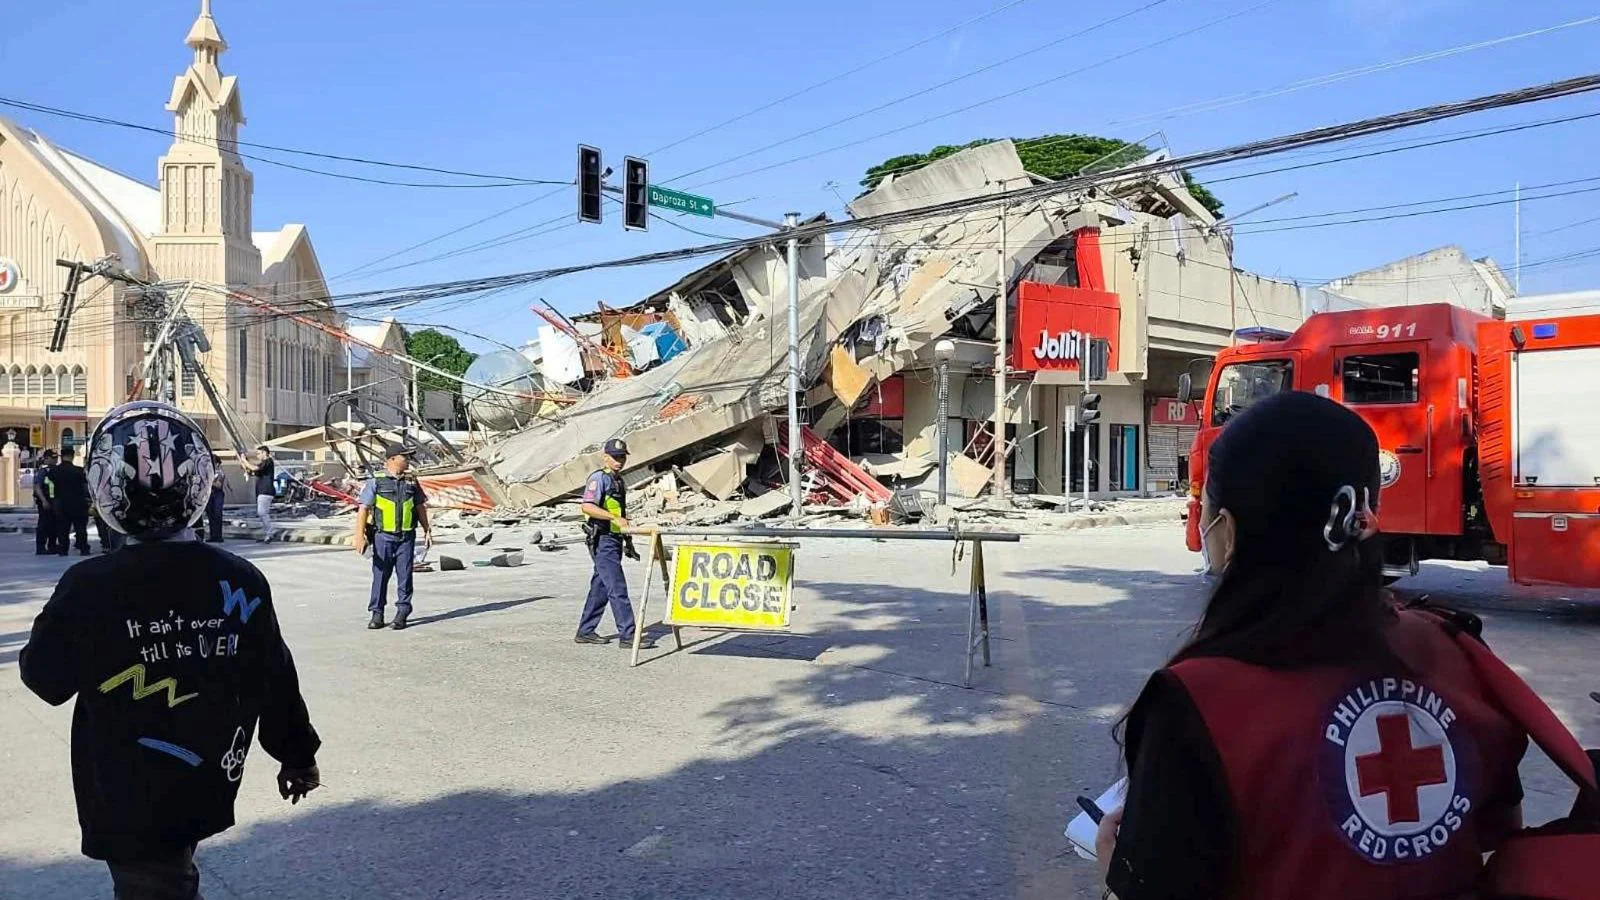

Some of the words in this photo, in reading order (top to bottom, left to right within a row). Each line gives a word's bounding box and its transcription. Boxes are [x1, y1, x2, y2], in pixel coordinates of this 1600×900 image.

[652, 191, 685, 206] Daproza
[1032, 329, 1081, 360] Jolli
[1376, 322, 1417, 339] 911
[691, 552, 777, 581] ROAD
[680, 581, 782, 613] CLOSE
[126, 619, 142, 639] It
[149, 609, 184, 634] ain't
[191, 618, 224, 630] over
[140, 641, 168, 662] till
[175, 641, 192, 659] its
[1326, 678, 1456, 747] PHILIPPINE
[1341, 814, 1387, 860] RED
[1394, 795, 1471, 859] CROSS
